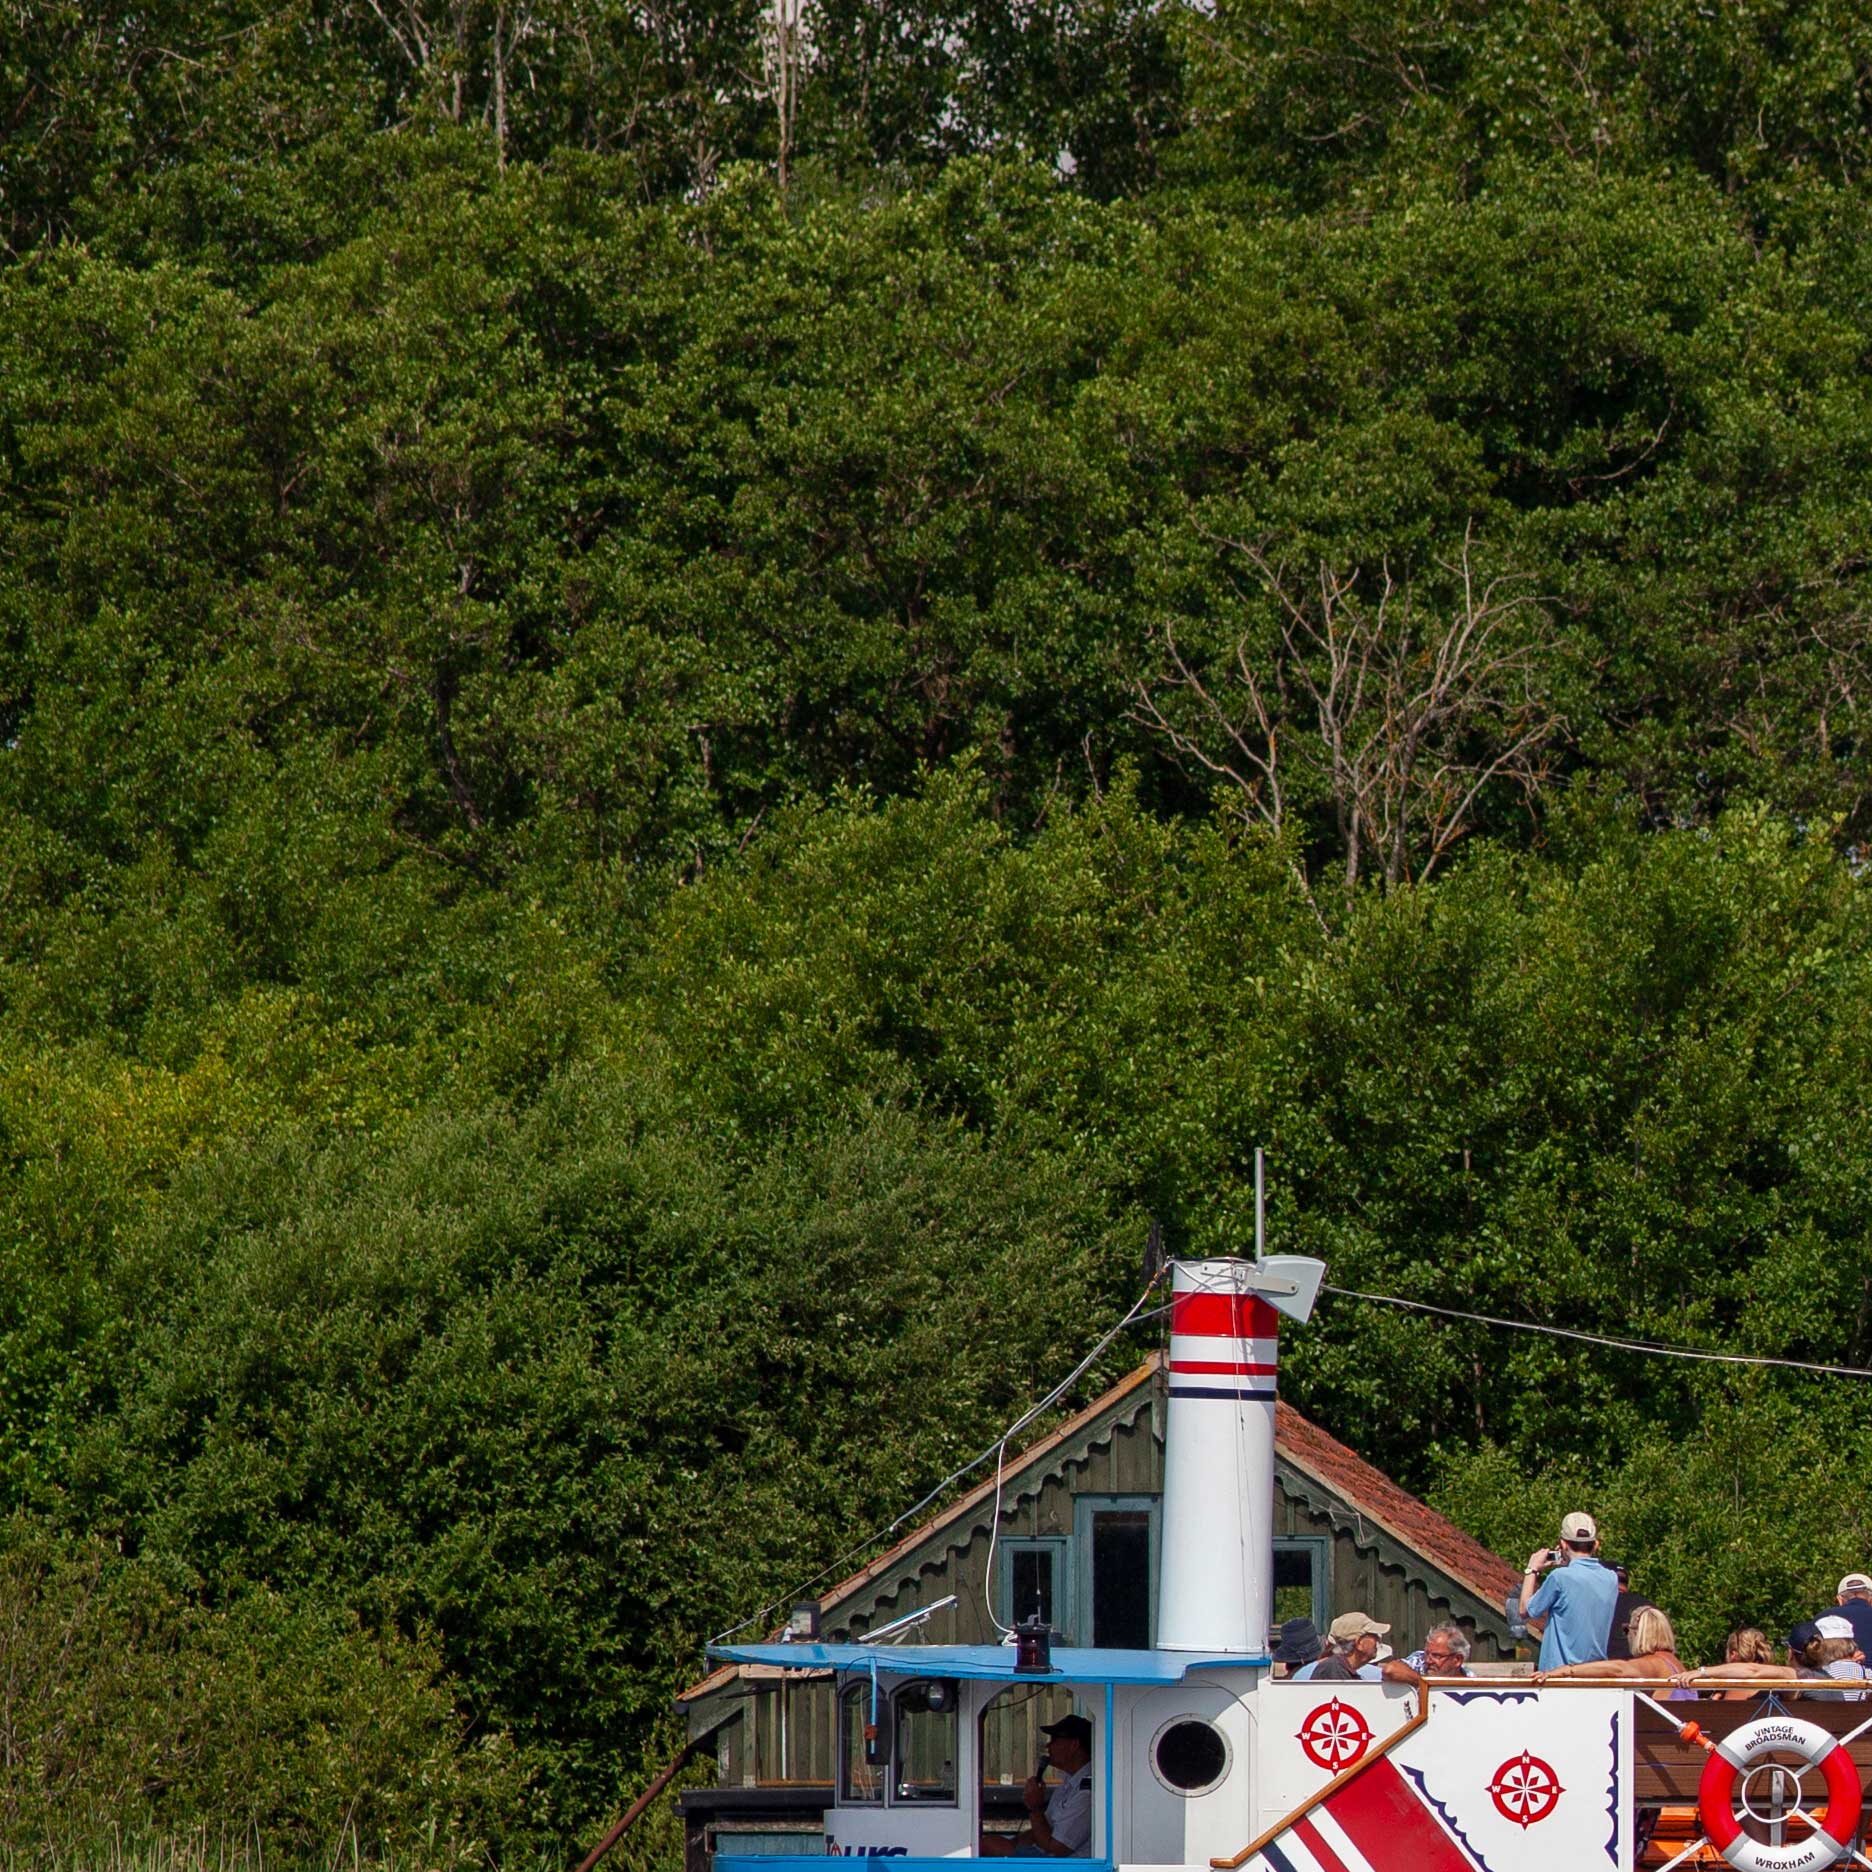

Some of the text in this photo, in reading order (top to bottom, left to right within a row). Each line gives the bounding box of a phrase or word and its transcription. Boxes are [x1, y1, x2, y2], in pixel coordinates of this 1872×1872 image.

[1331, 1703, 1339, 1711] N
[1754, 1726, 1794, 1737] VINTAGE
[1302, 1732, 1311, 1740] W
[1744, 1733, 1806, 1751] BROADSMAN
[1522, 1756, 1530, 1764] N
[1492, 1785, 1501, 1793] W
[1755, 1852, 1816, 1870] WROXHAM
